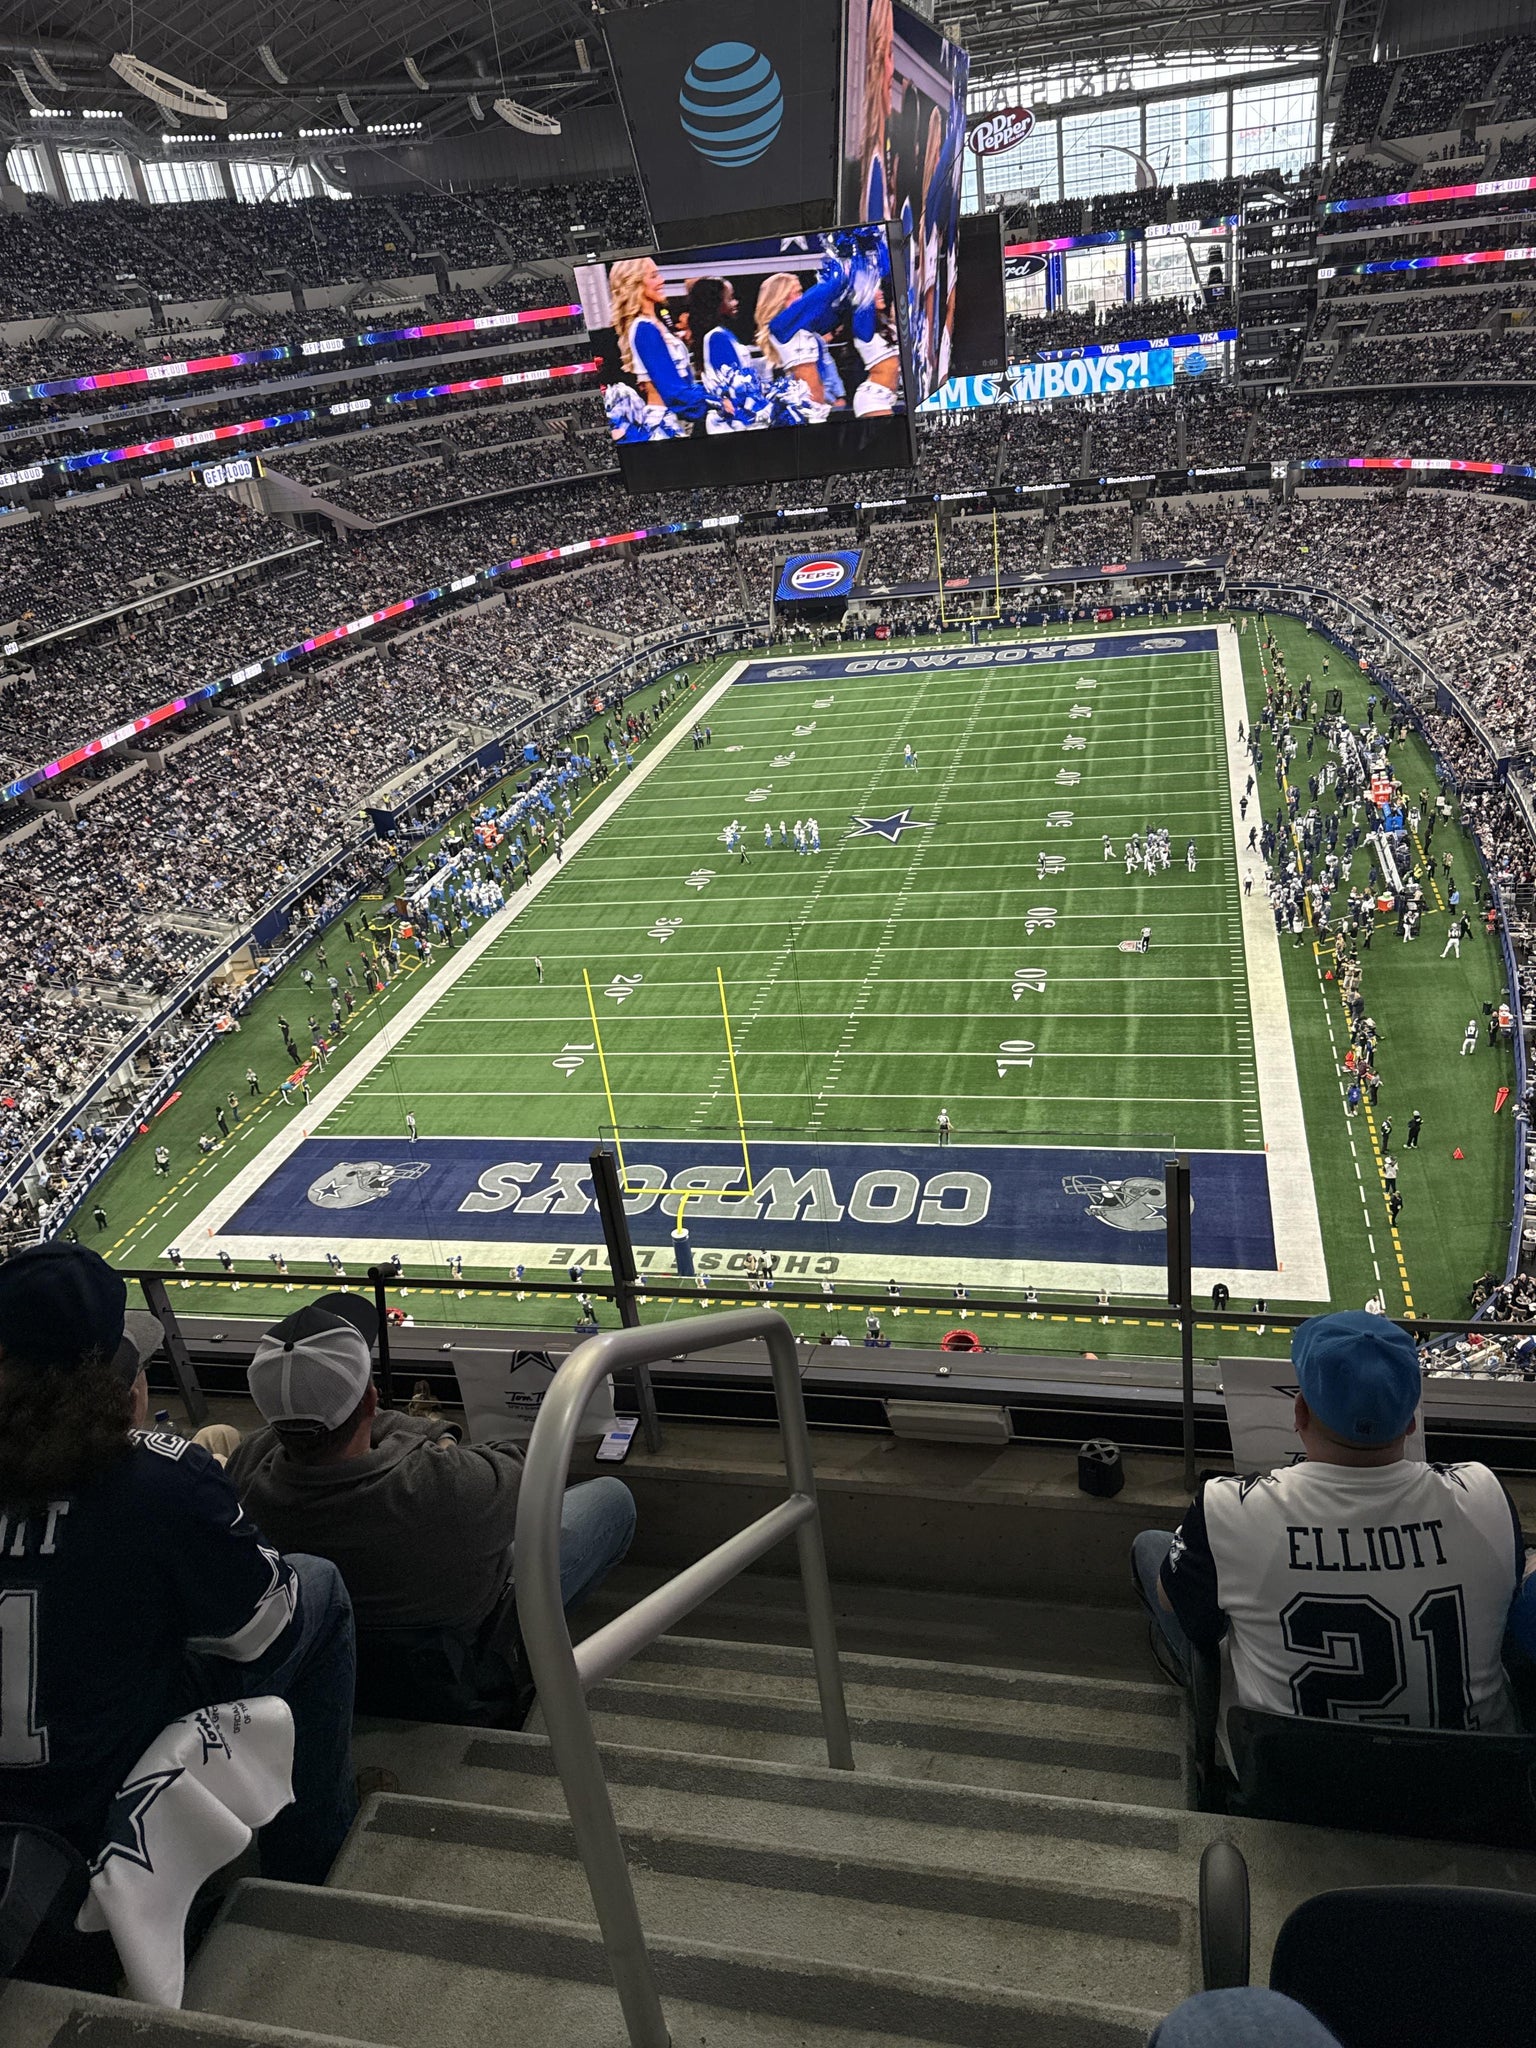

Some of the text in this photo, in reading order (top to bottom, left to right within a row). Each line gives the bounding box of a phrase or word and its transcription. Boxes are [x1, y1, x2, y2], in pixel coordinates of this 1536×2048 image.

[992, 113, 1016, 134] Dr
[977, 117, 1031, 153] Pepper
[1477, 179, 1528, 194] GET LOUD
[1147, 221, 1198, 237] GET LOUD
[1149, 338, 1170, 348] VISA
[1198, 332, 1219, 343] VISA
[1100, 343, 1120, 354] VISA
[204, 464, 251, 485] GET LOUD
[1195, 464, 1246, 476] Blockchain.com
[1022, 481, 1070, 493] Blockchain.com
[1106, 473, 1156, 485] Blockchain.com
[941, 489, 988, 501] Blockchain.com
[783, 505, 828, 517] Blockchain.com
[860, 498, 907, 510] Blockchain.com
[796, 570, 841, 581] PEPSI
[845, 642, 1095, 674] COWBOYS
[1075, 679, 1097, 690] 10
[1068, 706, 1092, 719] 20
[1061, 737, 1087, 751] 30
[1054, 771, 1081, 786] 40
[744, 788, 772, 802] 40
[1046, 810, 1075, 828] 50
[684, 868, 716, 886] 40
[1024, 907, 1058, 929] 30
[647, 917, 683, 938] 30
[603, 973, 643, 998] 20
[1011, 968, 1048, 993] 20
[552, 1042, 595, 1069] 10
[996, 1040, 1036, 1069] 10
[457, 1161, 992, 1227] COWBOYS
[549, 1247, 840, 1275] CHOOS LVE
[504, 1391, 533, 1402] Tom
[1286, 1519, 1448, 1572] ELLIOTT
[1279, 1584, 1480, 1731] 21
[232, 1704, 241, 1734] OFFICIAL
[244, 1714, 252, 1725] OF
[194, 1712, 223, 1766] Tom
